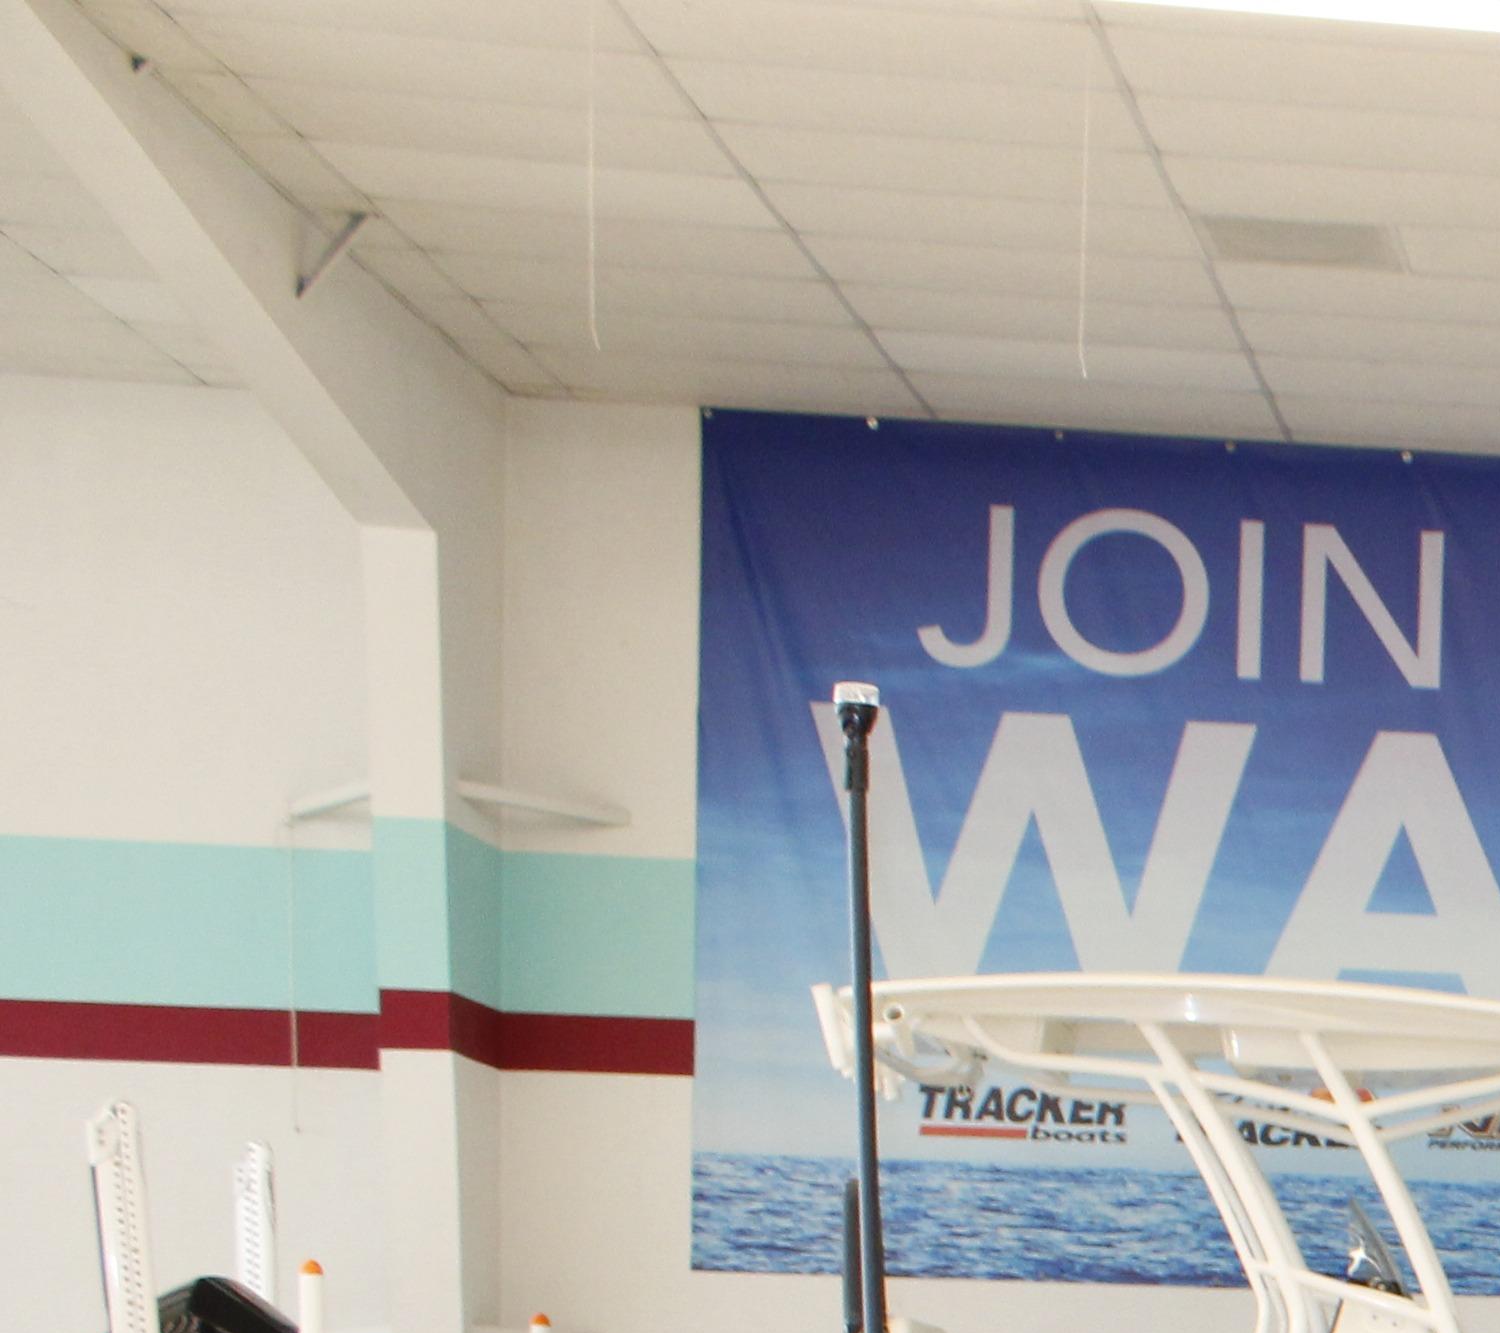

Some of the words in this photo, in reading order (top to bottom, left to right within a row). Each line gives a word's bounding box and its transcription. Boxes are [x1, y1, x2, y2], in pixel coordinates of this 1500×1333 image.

[919, 503, 1444, 689] JOIN
[918, 1083, 1127, 1126] TRACKER
[1026, 1125, 1128, 1143] boats
